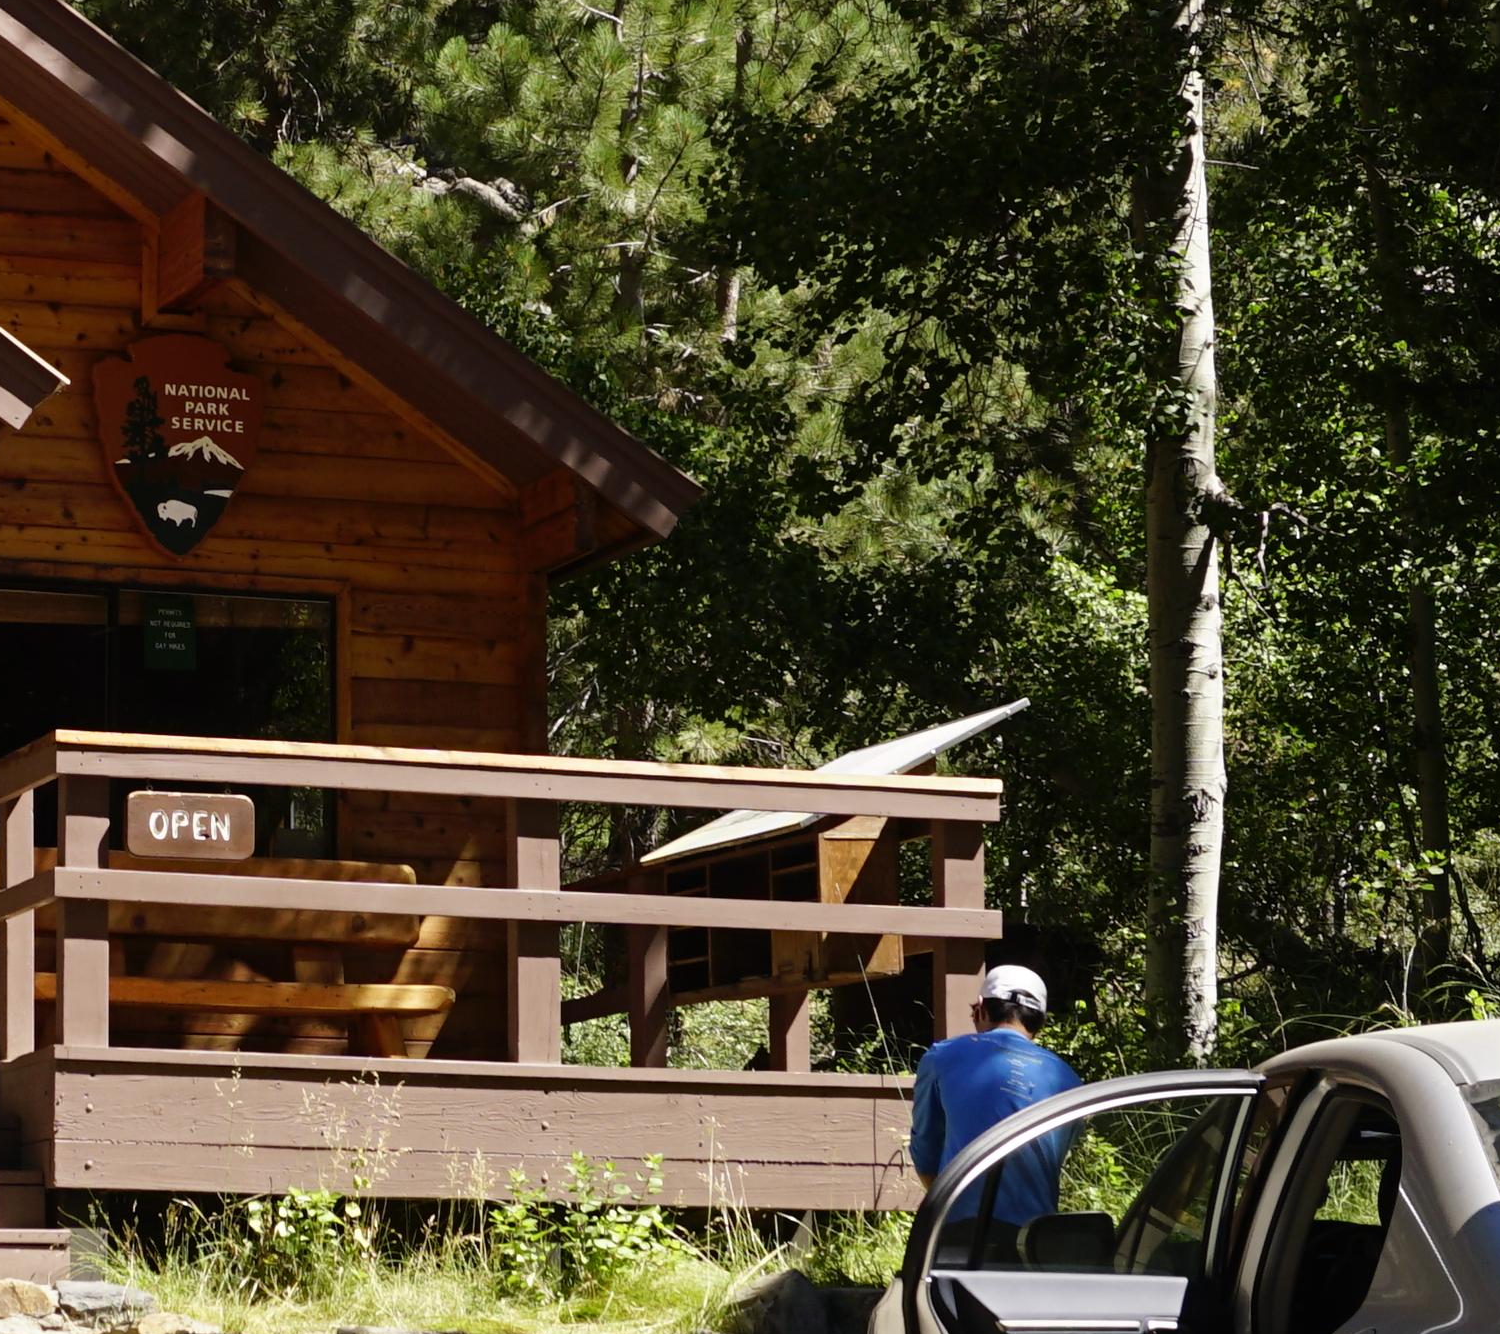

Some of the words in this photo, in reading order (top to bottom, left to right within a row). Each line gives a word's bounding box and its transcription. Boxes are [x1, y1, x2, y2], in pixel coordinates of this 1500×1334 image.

[164, 383, 250, 401] NATIONAL
[184, 401, 229, 416] PARK
[171, 416, 244, 433] SERVICE
[149, 808, 231, 841] OPEN
